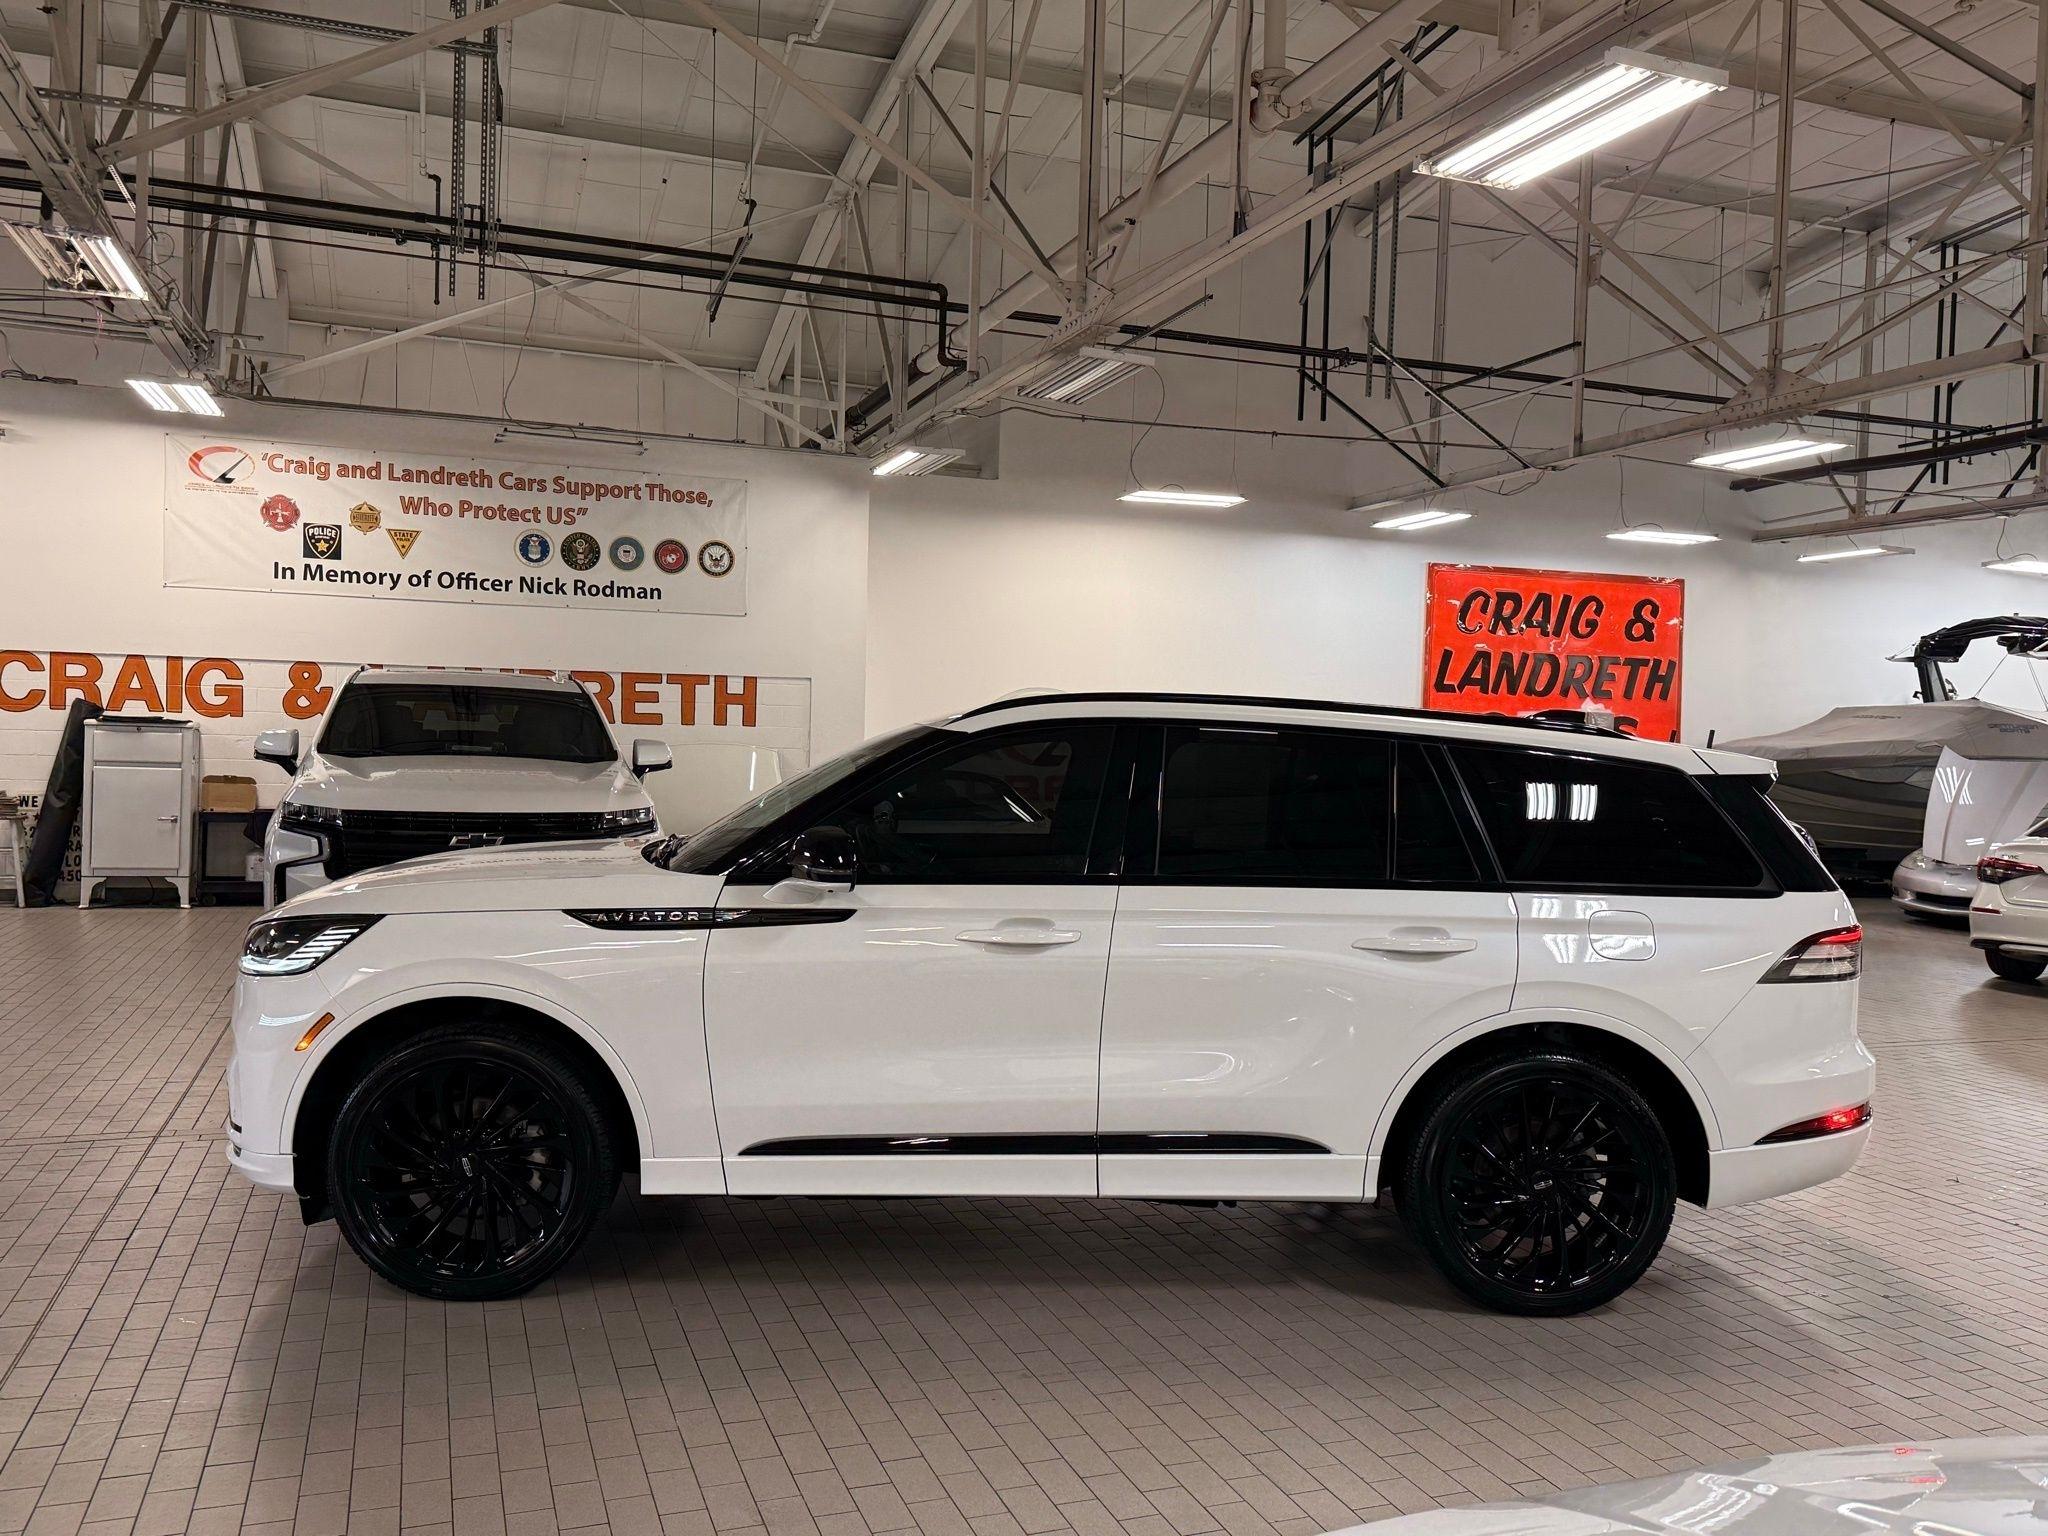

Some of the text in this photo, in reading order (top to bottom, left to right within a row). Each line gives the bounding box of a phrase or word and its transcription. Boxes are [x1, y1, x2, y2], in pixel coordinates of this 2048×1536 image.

[336, 461, 381, 480] and
[388, 463, 492, 488] Landreth
[499, 471, 547, 493] Cars
[553, 475, 641, 501] Support
[645, 483, 713, 507] Those,
[399, 495, 452, 518] Who
[458, 500, 541, 523] Protect
[308, 527, 338, 539] POLICE
[393, 531, 414, 539] STATE
[273, 562, 662, 600] In Memory of Officer Nick Rodman
[1456, 586, 1661, 643] CRAIG &
[0, 651, 244, 718] CRAIG
[282, 661, 334, 720] &
[1433, 647, 1678, 701] LANDRETH
[597, 911, 700, 921] AVIATOR
